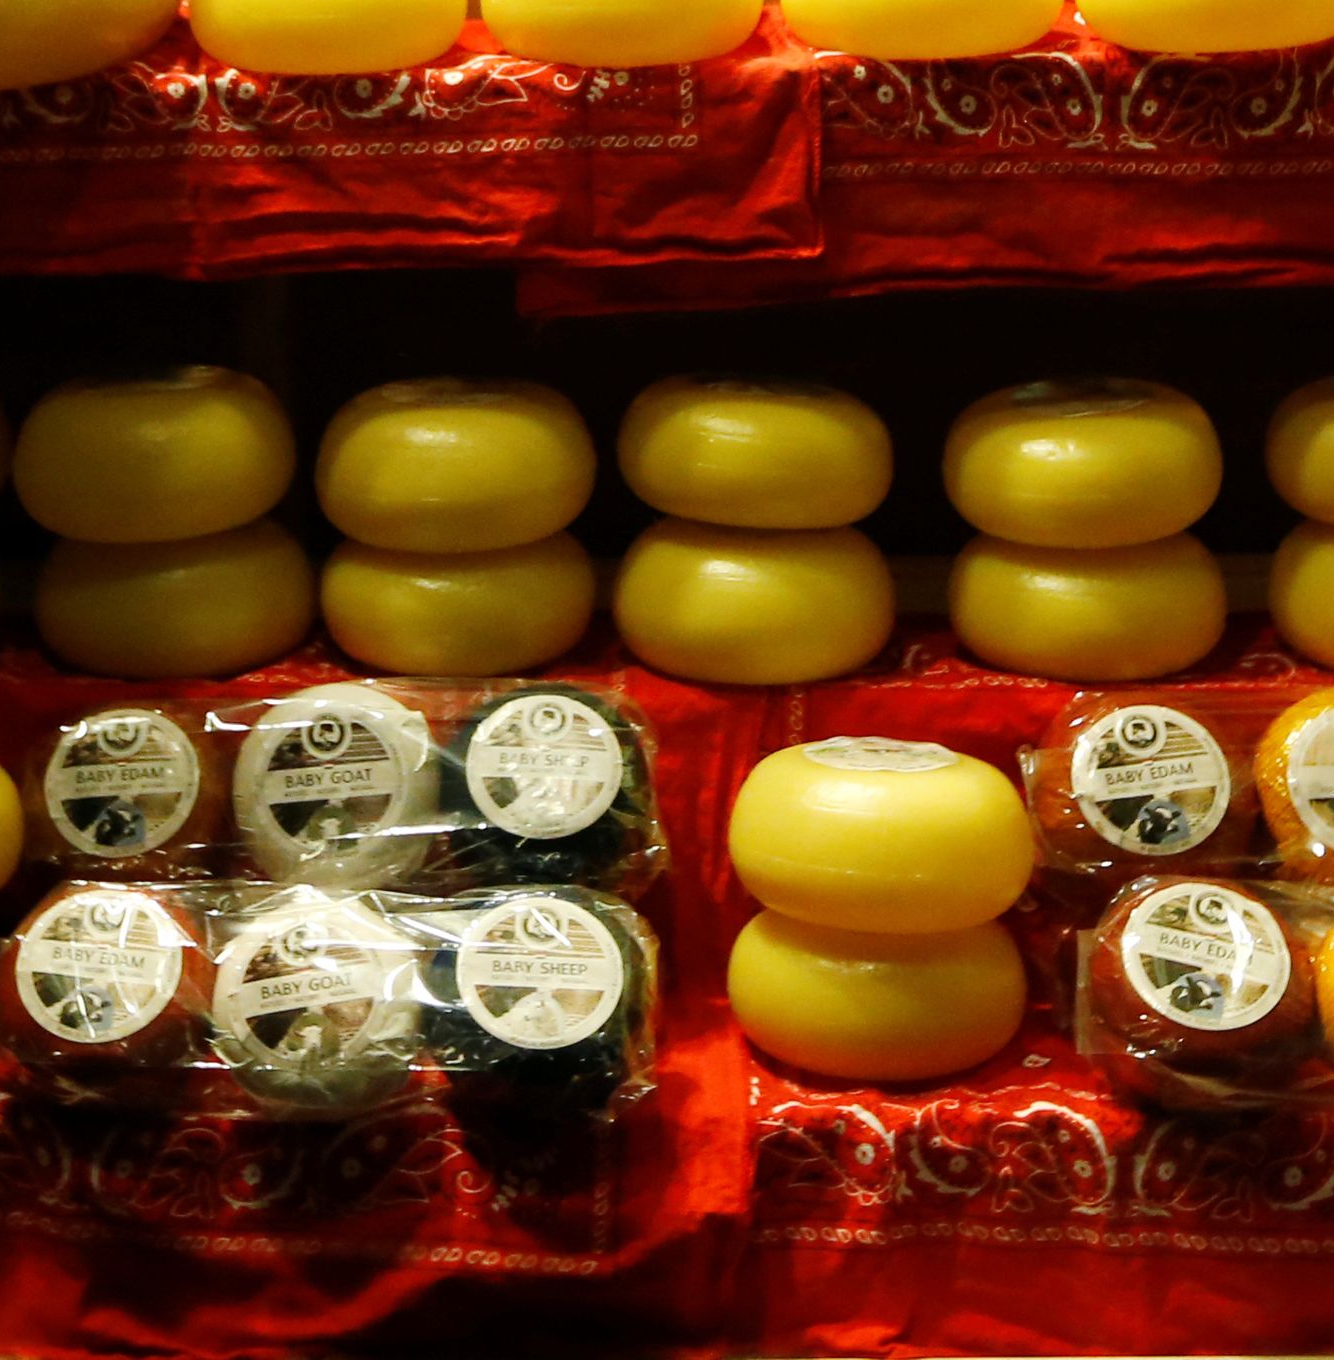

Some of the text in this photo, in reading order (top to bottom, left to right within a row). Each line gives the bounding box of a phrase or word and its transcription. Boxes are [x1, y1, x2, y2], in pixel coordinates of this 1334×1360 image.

[75, 767, 165, 784] BABY EDAM
[285, 768, 373, 788] BABY GOAT
[1104, 762, 1195, 785] BABY EDAM
[1158, 932, 1202, 954] BABY
[52, 946, 146, 968] BABY EDAM
[492, 959, 589, 976] BABY SHEEP
[260, 981, 302, 1000] BABY
[308, 972, 354, 990] GOAT
